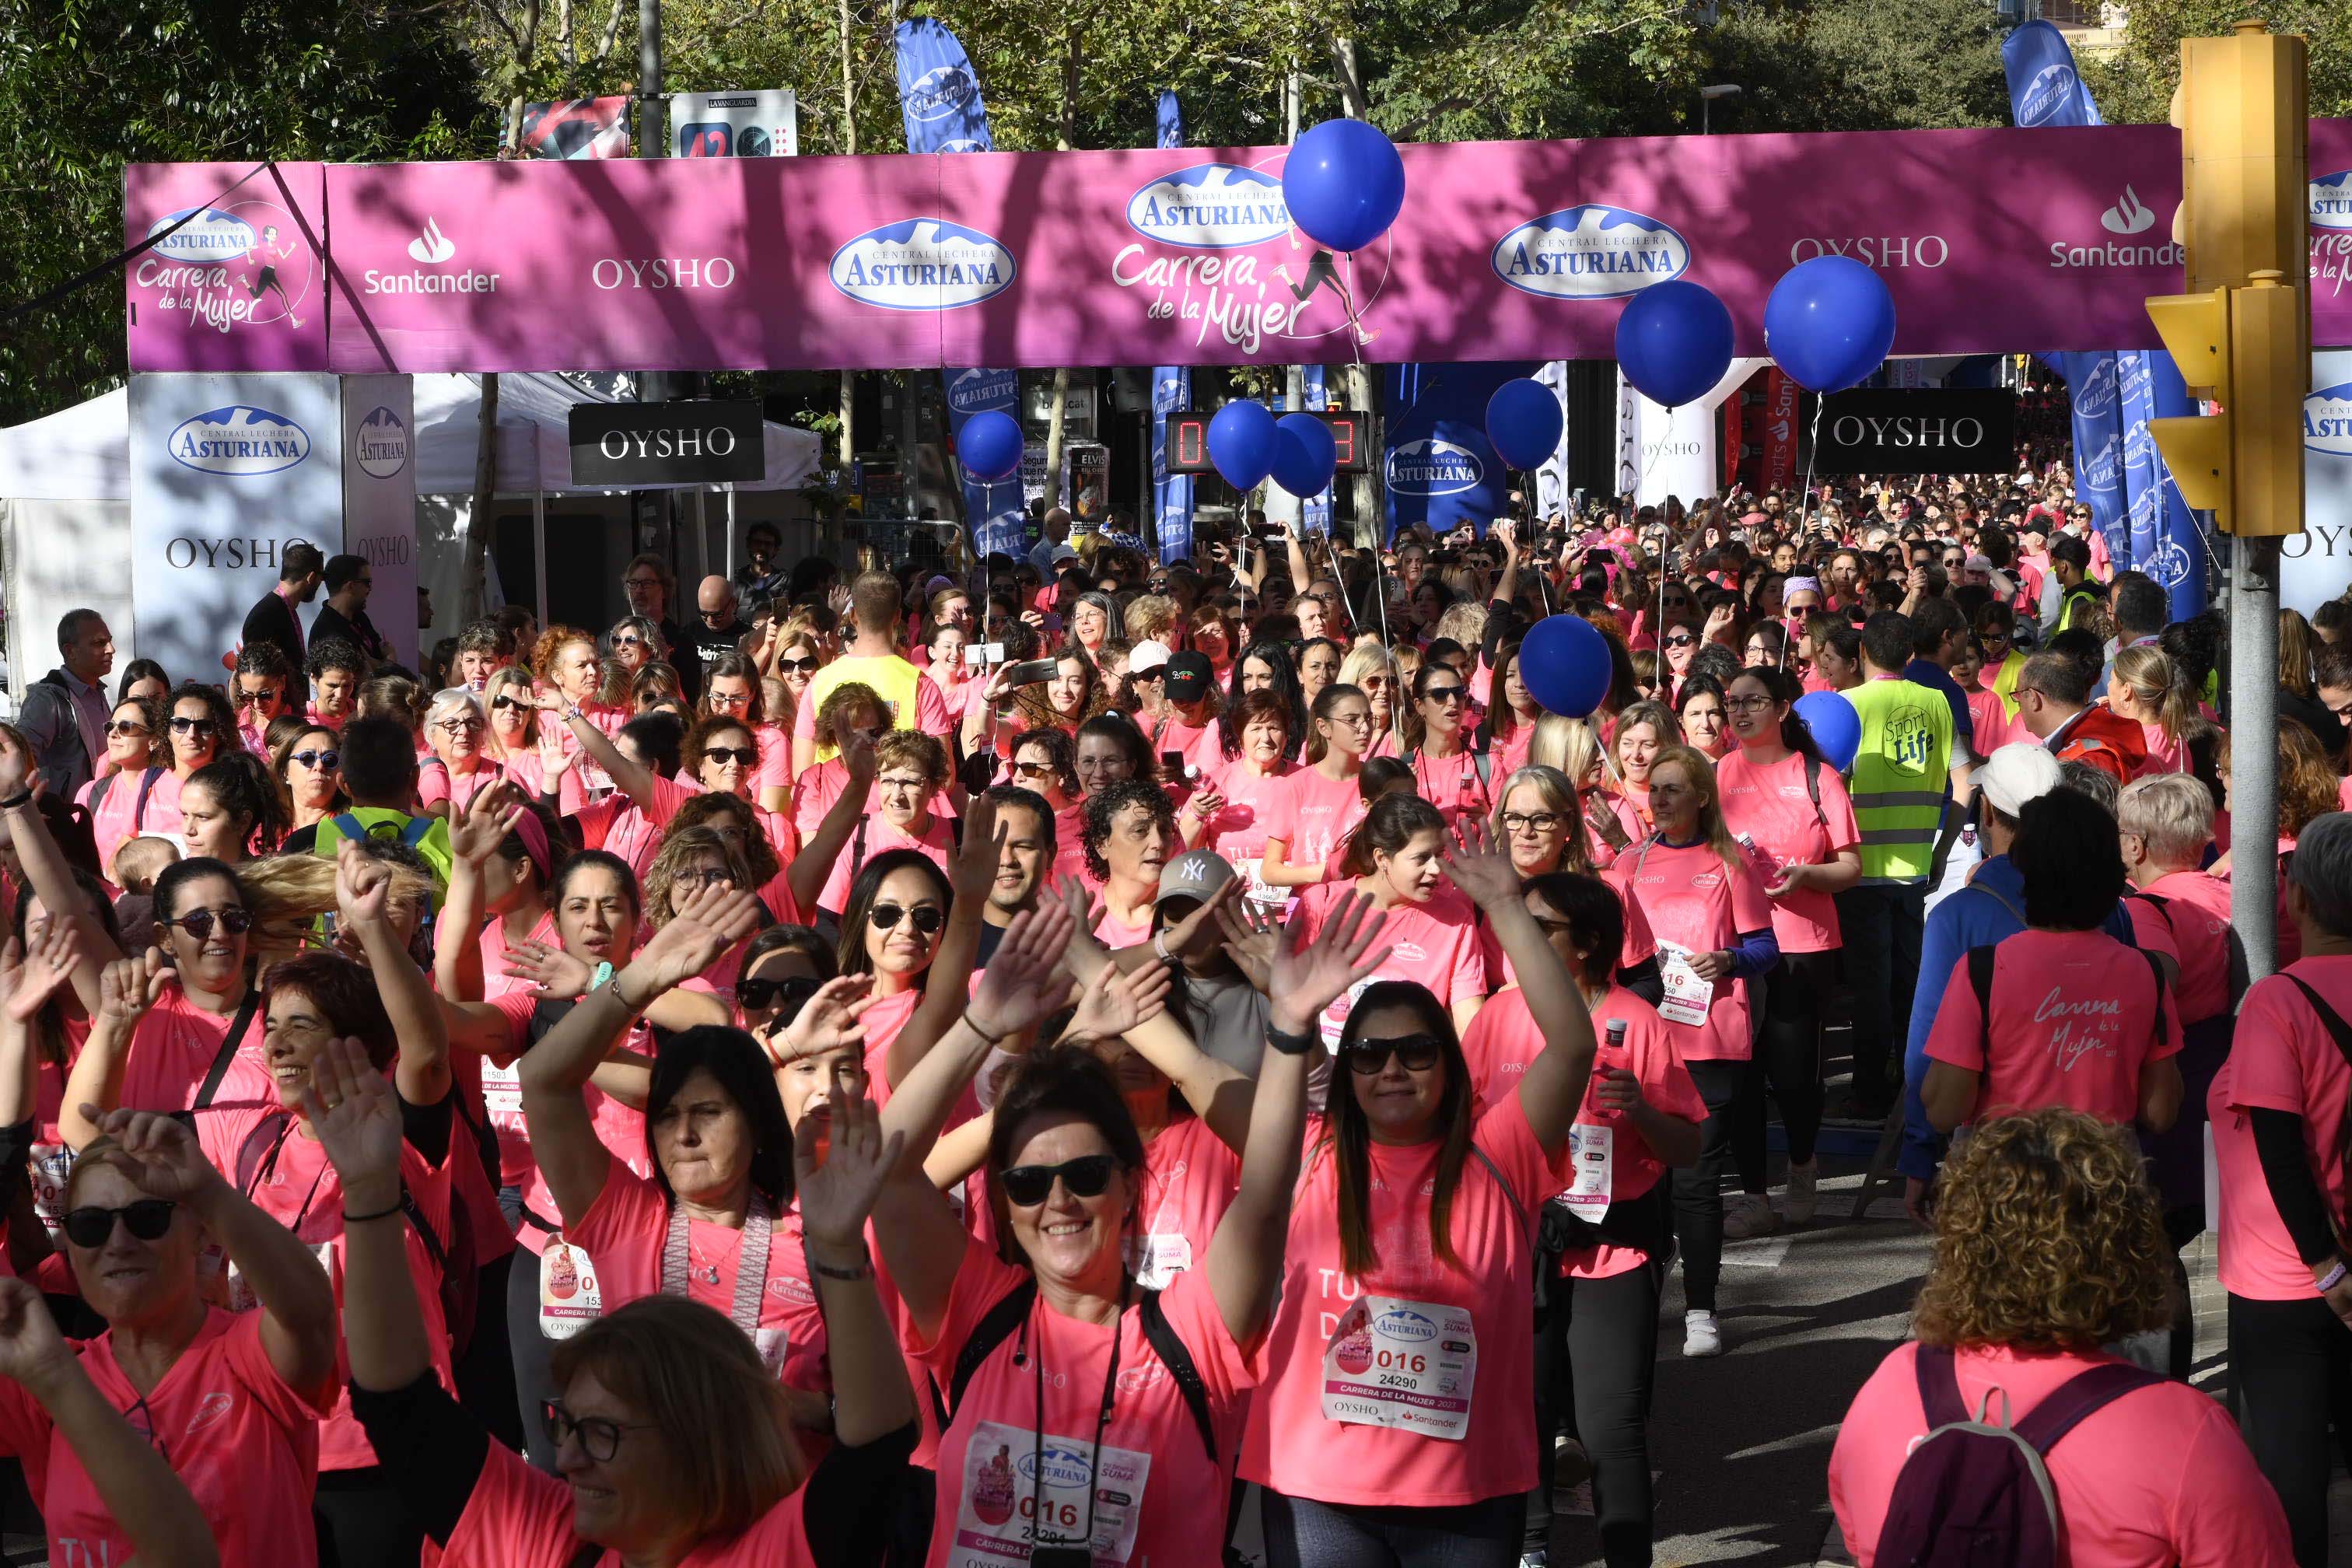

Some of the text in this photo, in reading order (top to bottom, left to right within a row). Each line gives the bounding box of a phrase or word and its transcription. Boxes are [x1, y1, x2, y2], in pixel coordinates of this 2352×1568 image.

[717, 98, 756, 107] VANGUARDIA
[1140, 195, 1289, 226] ASTURIANA
[1538, 236, 1668, 247] CENTRAL LECHERA
[872, 250, 930, 259] CENTRAL
[1111, 243, 1258, 287] Carrera
[1507, 241, 1675, 275] ASTURIANA
[2050, 241, 2186, 268] Santande
[136, 258, 228, 288] Carrera
[592, 257, 736, 290] OYSHO
[844, 253, 1002, 287] ASTURIANA
[2323, 257, 2336, 278] la
[363, 268, 501, 294] Santander
[159, 285, 262, 334] de la Mujer
[1147, 282, 1313, 355] de la Mujer
[1776, 377, 1794, 417] Sant
[250, 429, 296, 437] LECHERA
[600, 426, 737, 460] OYSHO
[1179, 422, 1201, 464] 0
[1833, 415, 1984, 448] OYSHO
[179, 432, 301, 458] ASTURIANA
[359, 432, 405, 461] ASTURIANA
[1642, 442, 1701, 456] OYSHO
[1081, 454, 1105, 464] ELVIS
[1389, 461, 1477, 483] ASTURIANA
[1885, 710, 1927, 742] Sport
[1894, 730, 1934, 766] Life
[1728, 784, 1759, 795] OYSHO
[1300, 805, 1332, 815] OYSHO
[1181, 858, 1206, 880] NY
[1671, 997, 1689, 1006] MUJER
[2034, 986, 2122, 1022] Carrera
[1673, 1008, 1700, 1020] Santander
[2046, 1020, 2107, 1072] Mujer
[1585, 1139, 1605, 1147] SUMA
[771, 1280, 817, 1303] ASTURIAN
[1318, 1267, 1360, 1301] TU
[554, 1308, 586, 1317] CARRERA
[1378, 1319, 1433, 1338] ASTURIANA
[1443, 1324, 1471, 1335] SUMA
[1377, 1350, 1426, 1373] 016
[1379, 1374, 1418, 1390] 24290
[1340, 1384, 1458, 1409] CARRERA DE LA MUJER 2023
[1334, 1402, 1379, 1416] OYSHO
[1413, 1413, 1458, 1429] Santander
[1101, 1468, 1135, 1482] SUMA
[1020, 1496, 1078, 1527] 016
[975, 1537, 1020, 1555] CARRERA
